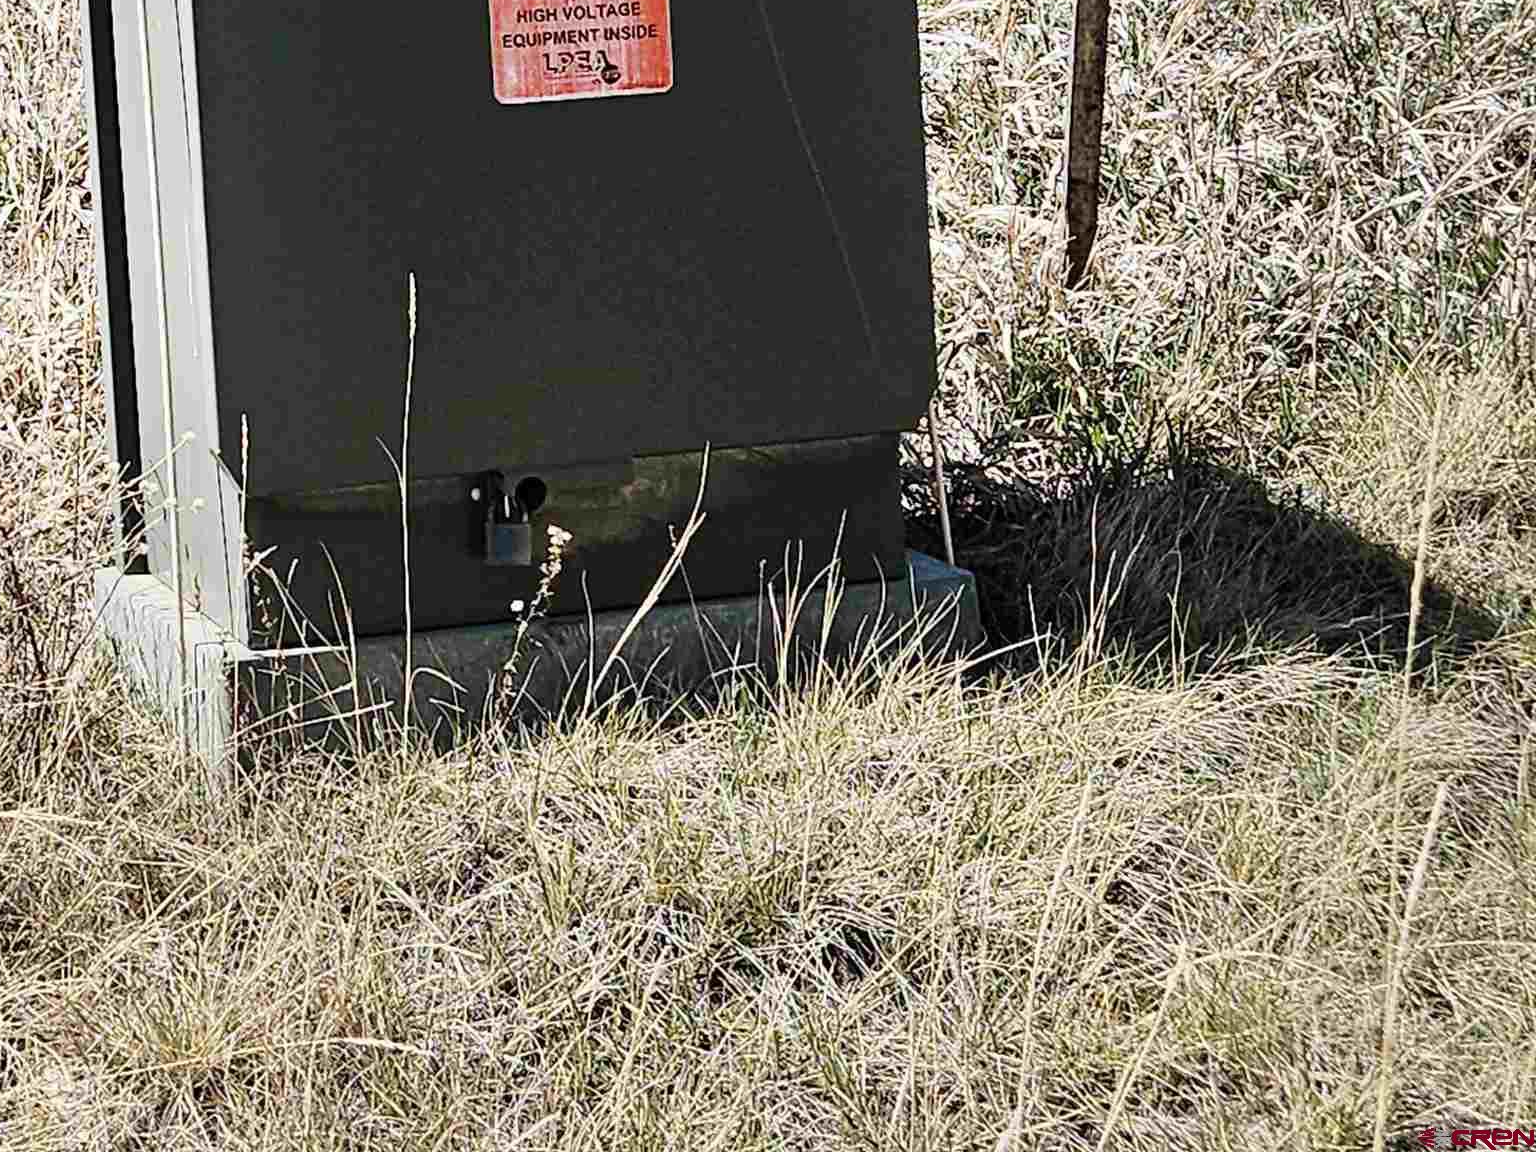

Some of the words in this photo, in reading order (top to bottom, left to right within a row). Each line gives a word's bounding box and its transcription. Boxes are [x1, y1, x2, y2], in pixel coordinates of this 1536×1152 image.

[516, 8, 557, 23] HIGH
[564, 1, 641, 20] VOLTAGE
[502, 29, 598, 48] EQUIPMENT
[604, 24, 658, 41] INSIDE
